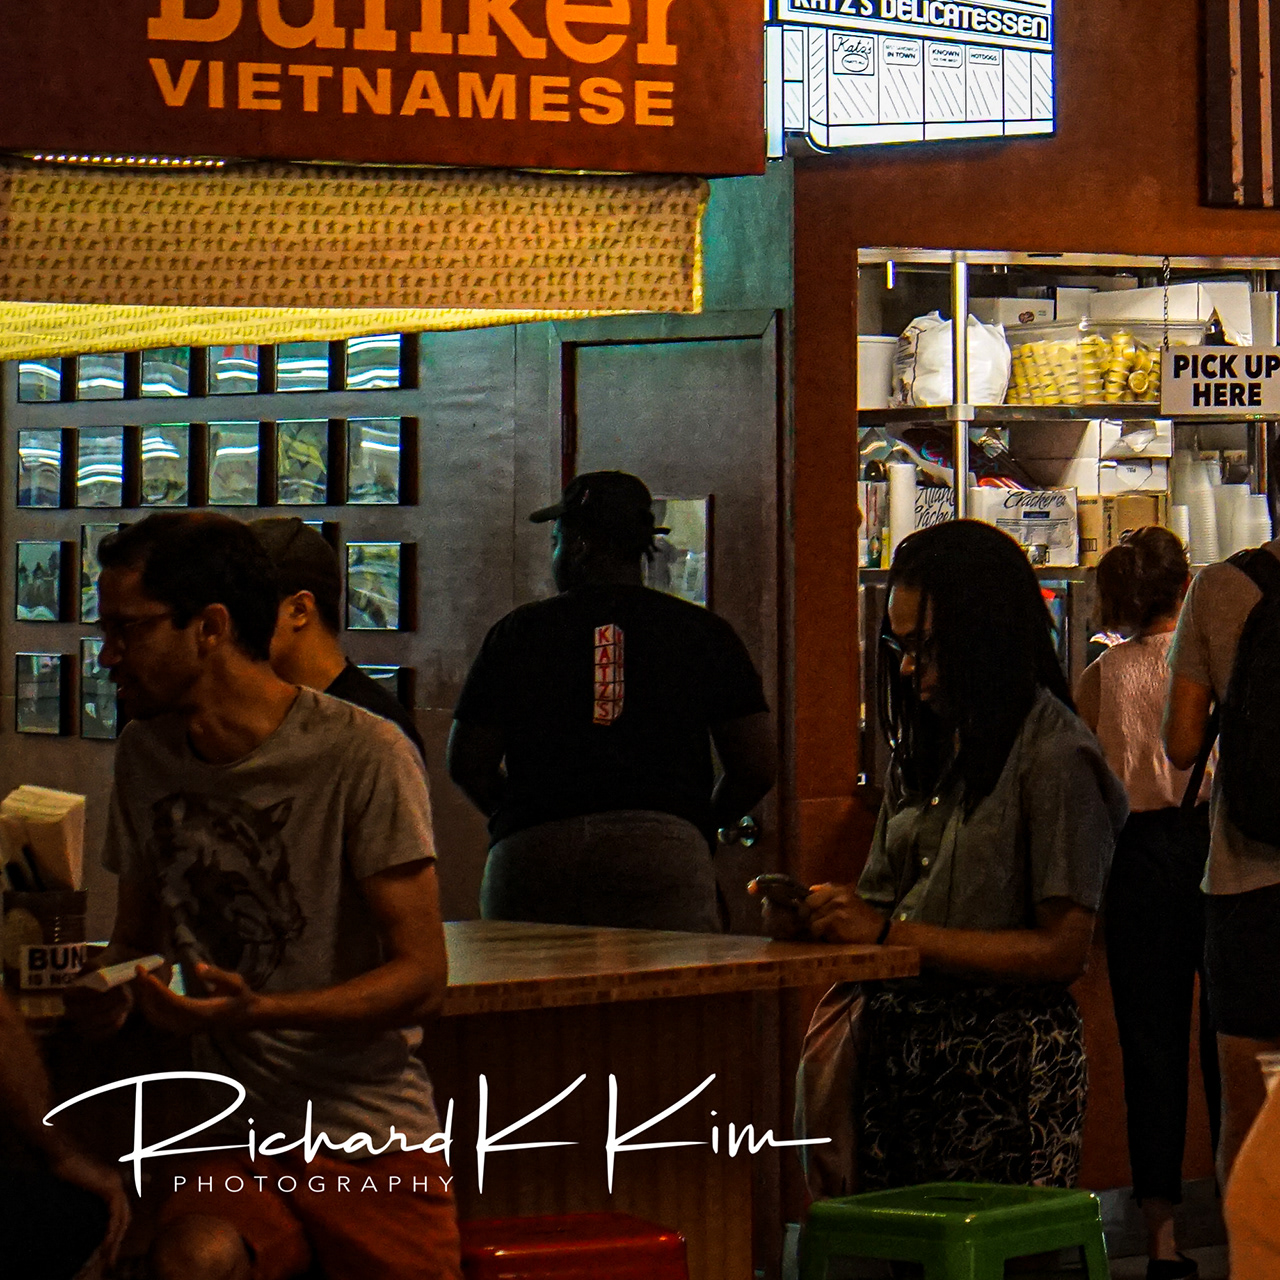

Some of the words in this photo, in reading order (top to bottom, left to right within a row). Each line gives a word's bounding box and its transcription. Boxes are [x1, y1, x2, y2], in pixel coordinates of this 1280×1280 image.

[932, 49, 960, 57] KNOWN
[149, 58, 676, 127] VIETNAMESE
[1173, 355, 1241, 379] PICK
[1245, 354, 1280, 379] UP
[1193, 382, 1262, 407] HERE
